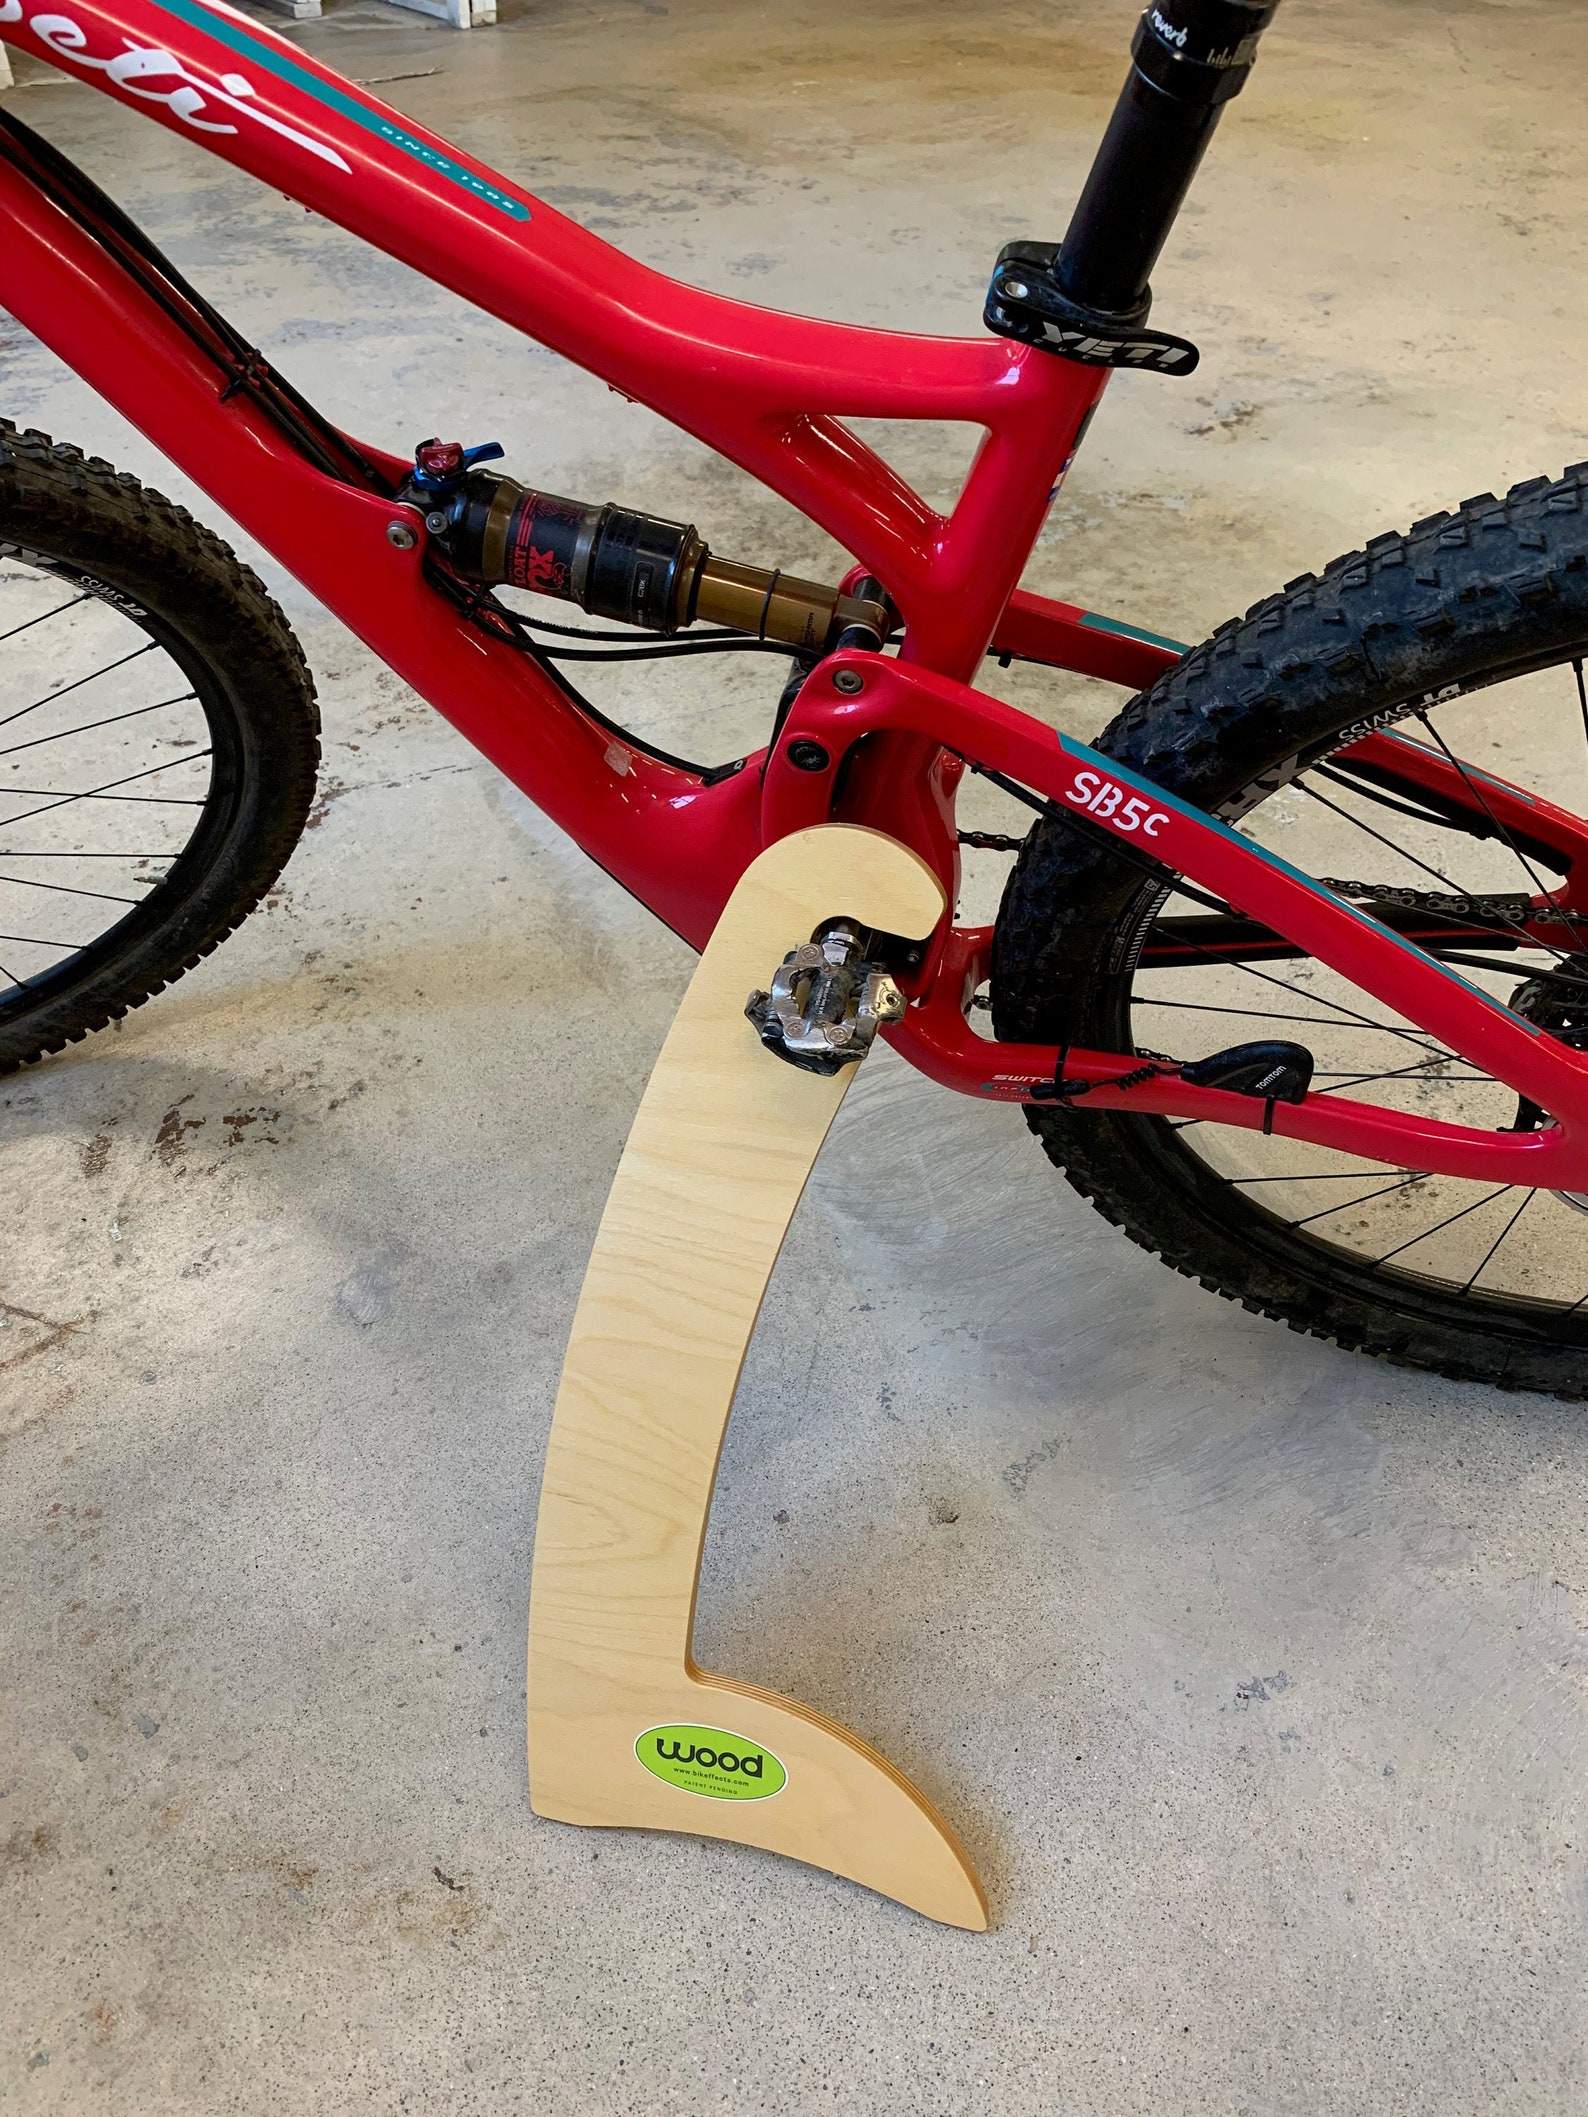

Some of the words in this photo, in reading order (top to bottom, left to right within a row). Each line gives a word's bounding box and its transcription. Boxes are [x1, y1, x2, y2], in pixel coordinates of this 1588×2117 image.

[1152, 9, 1188, 47] reverb
[381, 126, 450, 169] SINCE
[514, 545, 527, 586] LOAT
[1420, 683, 1462, 708] DT
[1338, 702, 1411, 741] SWISS
[1064, 771, 1170, 837] SB5c
[656, 1738, 763, 1779] wood
[673, 1766, 750, 1787] www.bikeffects.com
[709, 1785, 738, 1795] PENDING
